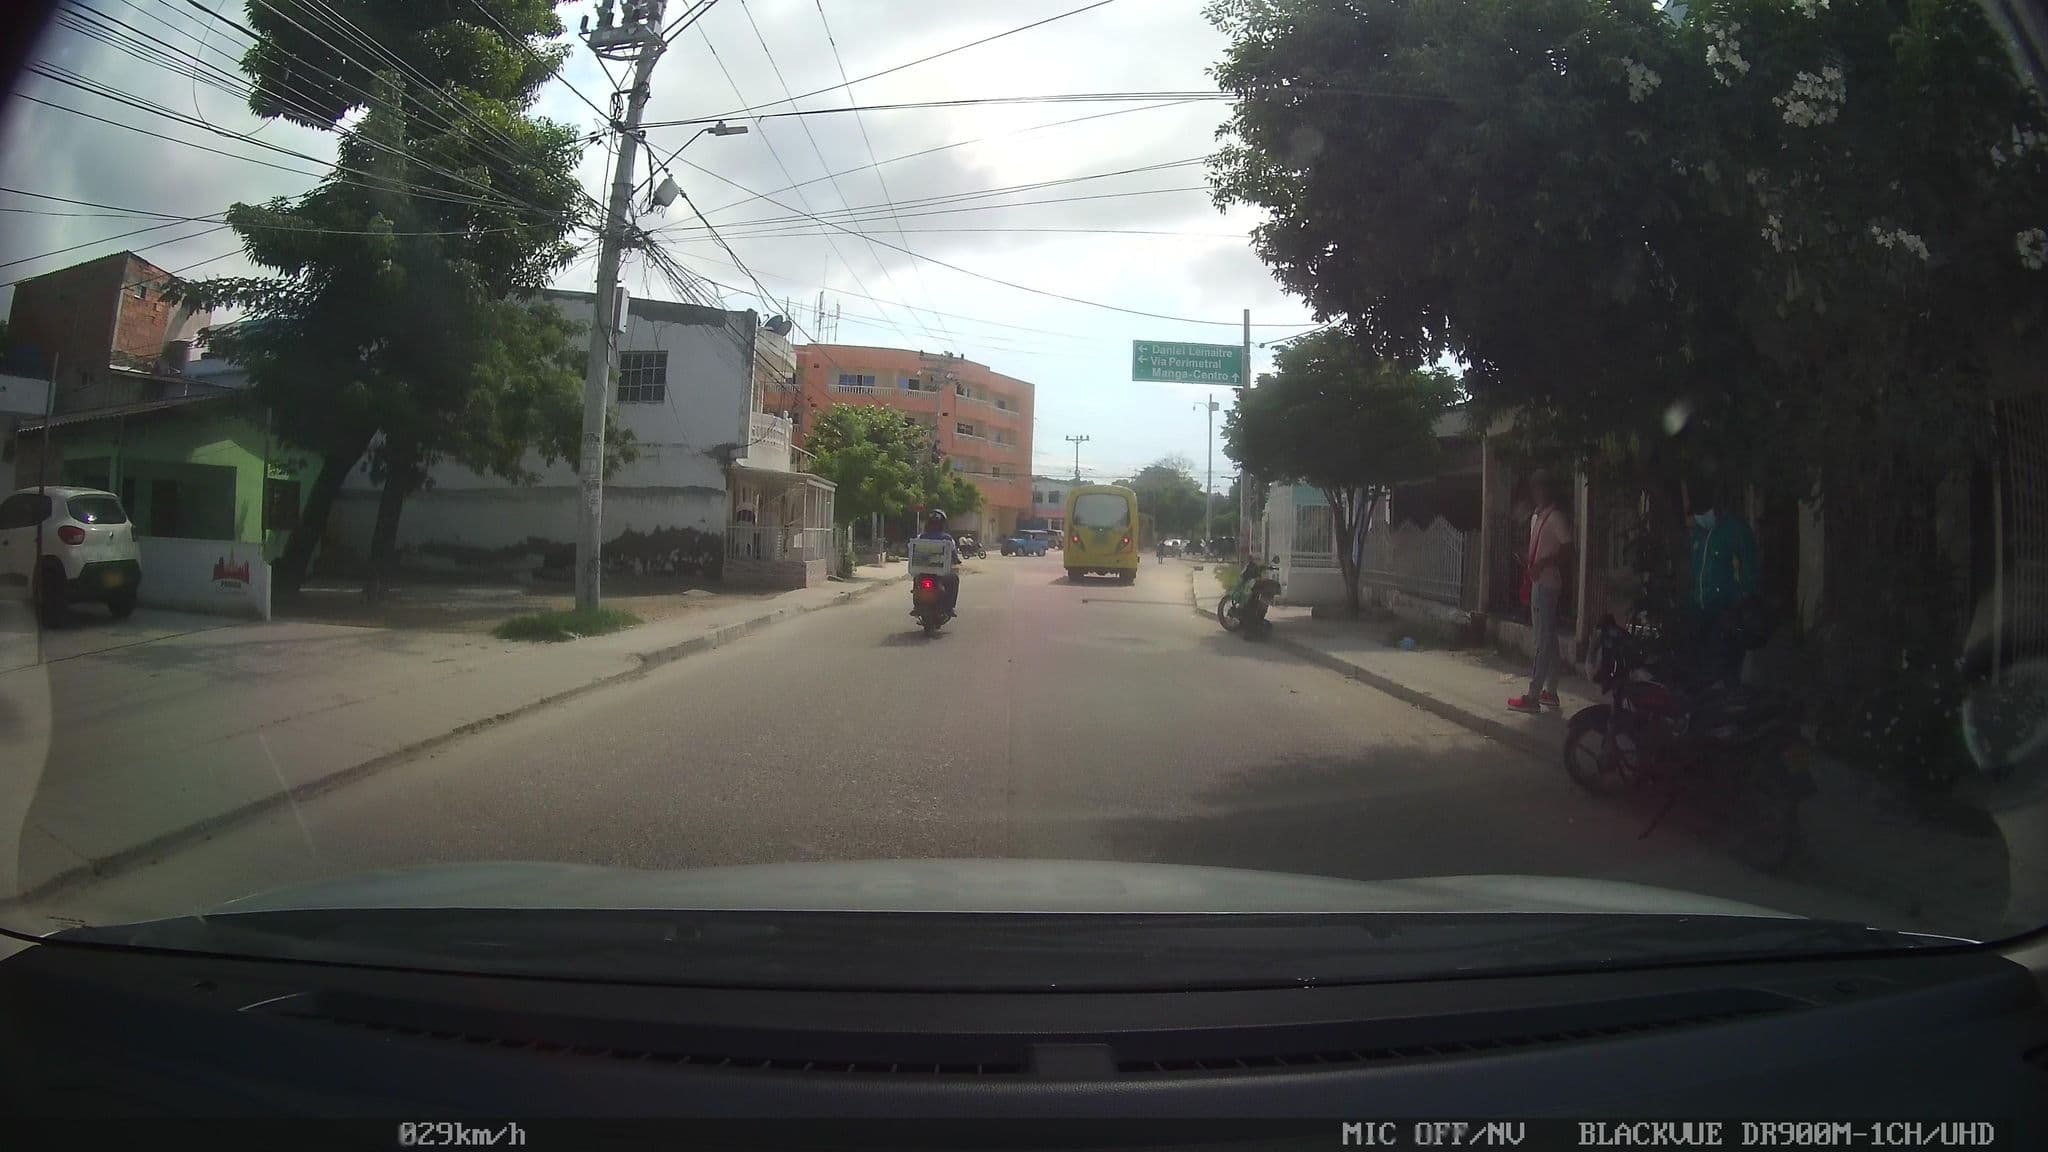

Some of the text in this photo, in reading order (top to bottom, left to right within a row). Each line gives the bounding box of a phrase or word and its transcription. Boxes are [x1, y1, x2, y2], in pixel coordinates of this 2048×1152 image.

[1152, 344, 1186, 356] Daniel
[1150, 355, 1222, 369] Via Perimetral
[1152, 367, 1229, 380] Manga-Centro
